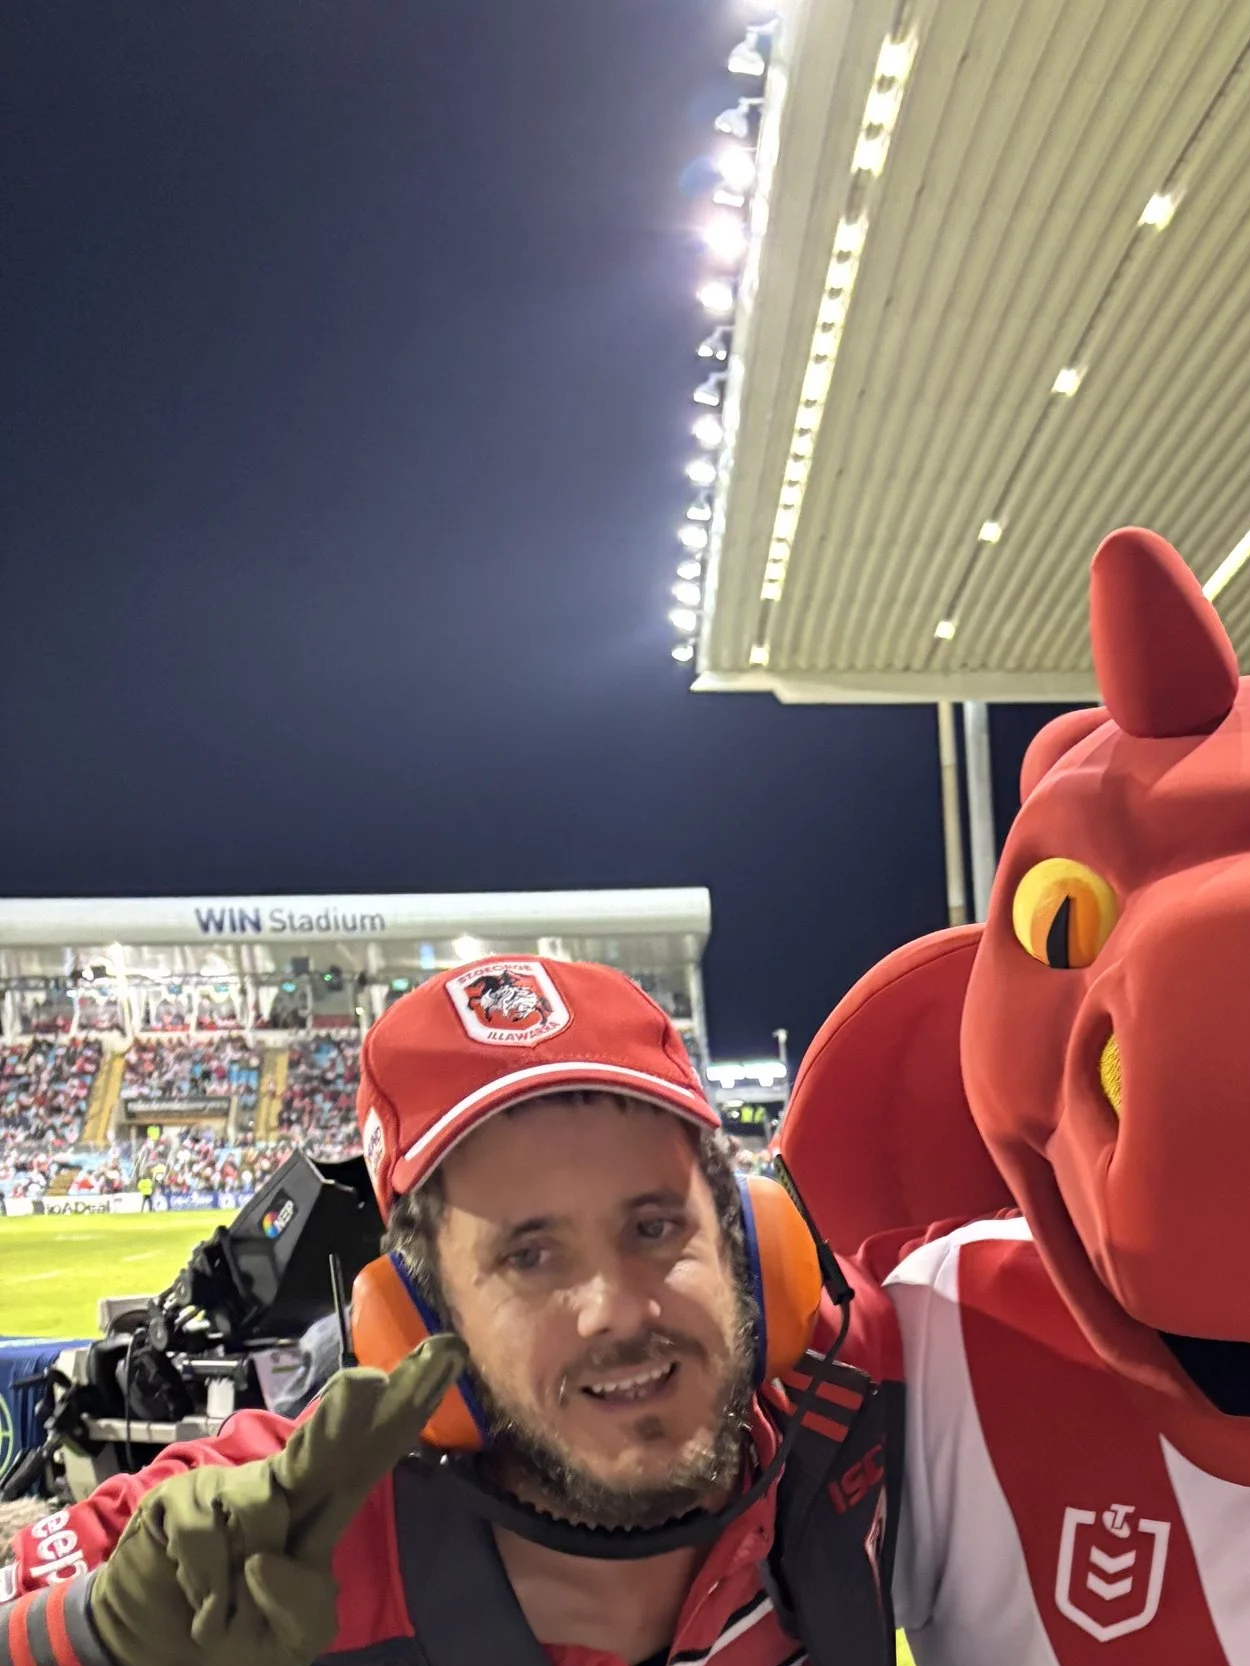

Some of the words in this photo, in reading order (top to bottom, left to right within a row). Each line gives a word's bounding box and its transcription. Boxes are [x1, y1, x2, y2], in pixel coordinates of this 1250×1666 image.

[195, 907, 263, 934] WIN
[268, 906, 385, 933] Stadium
[273, 1199, 294, 1233] NEP
